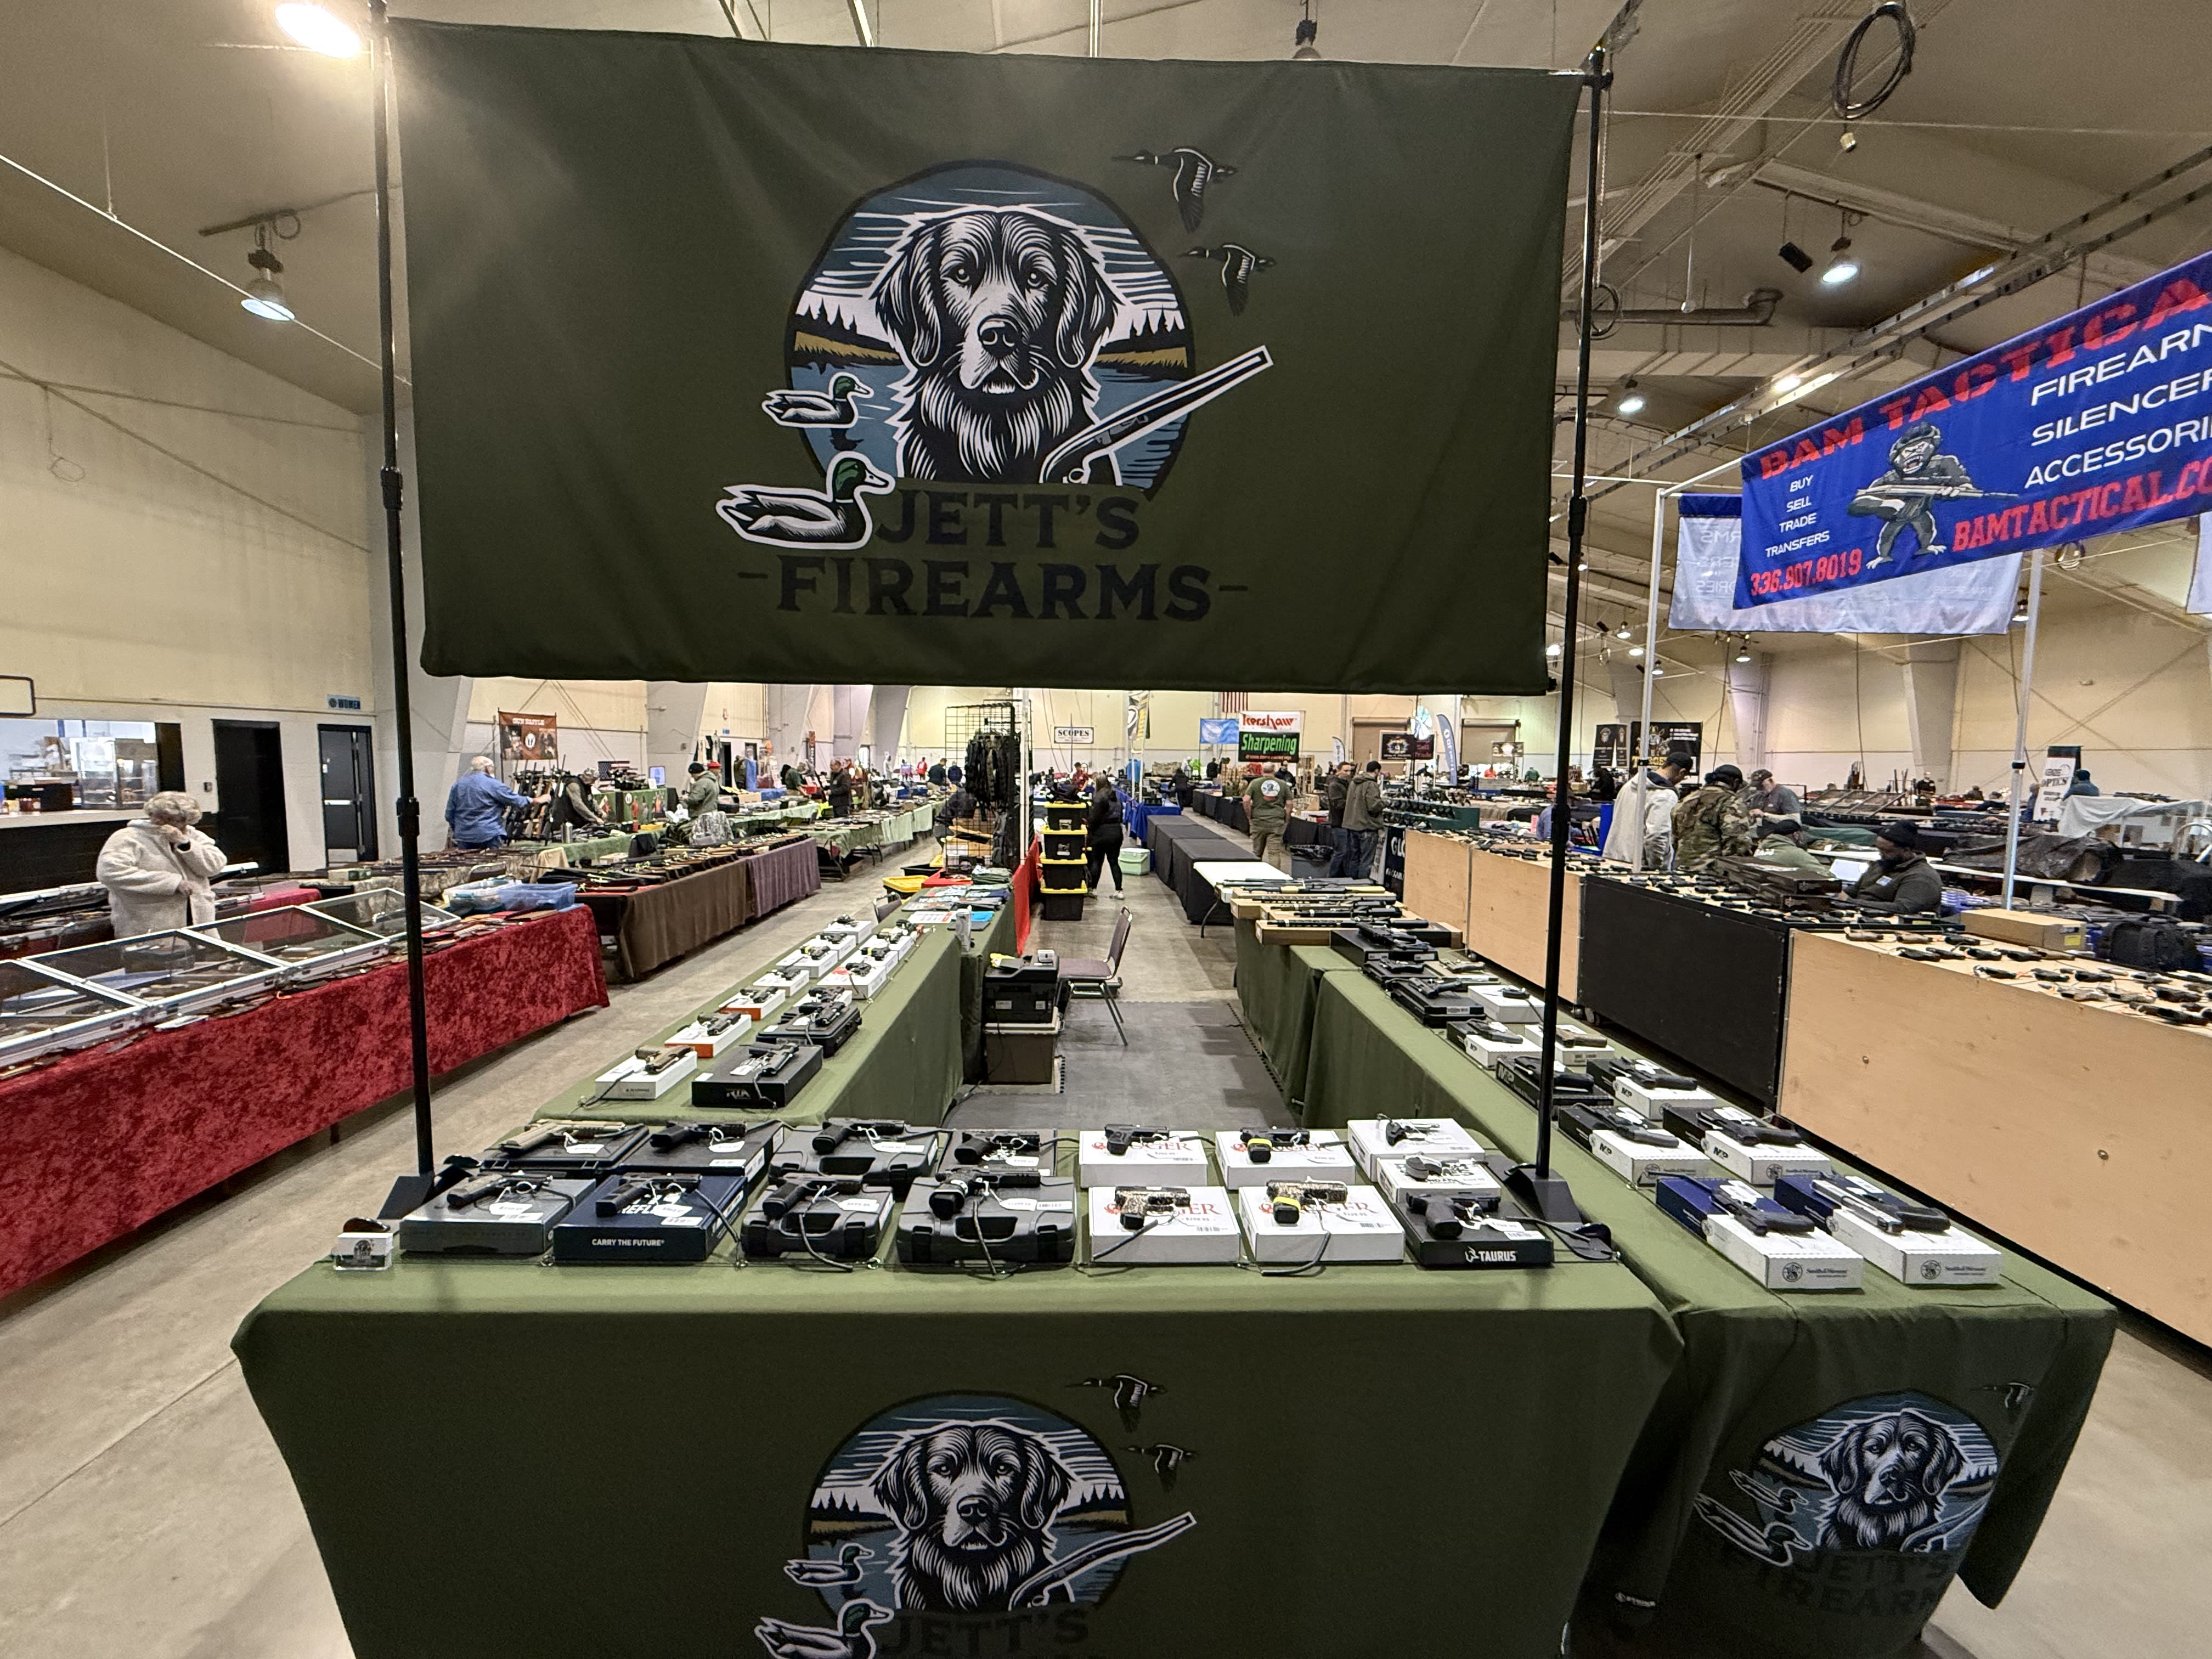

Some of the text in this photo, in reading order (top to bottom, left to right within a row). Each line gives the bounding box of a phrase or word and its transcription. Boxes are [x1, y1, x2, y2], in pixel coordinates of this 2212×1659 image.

[1760, 416, 1864, 480] BAM
[2024, 414, 2212, 489] ACCESSORI
[1790, 475, 1813, 492] BUY
[1786, 496, 1812, 513] SELL
[874, 489, 1141, 551] JETT'S
[1779, 513, 1817, 533] TRADE
[1765, 531, 1830, 558] TRANSFERS
[1751, 548, 1863, 596] 336.907.8019
[776, 554, 1212, 622] FIREARMS
[1057, 729, 1090, 737] SCOPES
[1240, 733, 1297, 755] Sharpening
[591, 1238, 617, 1246] CARRY
[1478, 1250, 1517, 1262] TAURUS
[879, 1608, 1090, 1656] JETT'S
